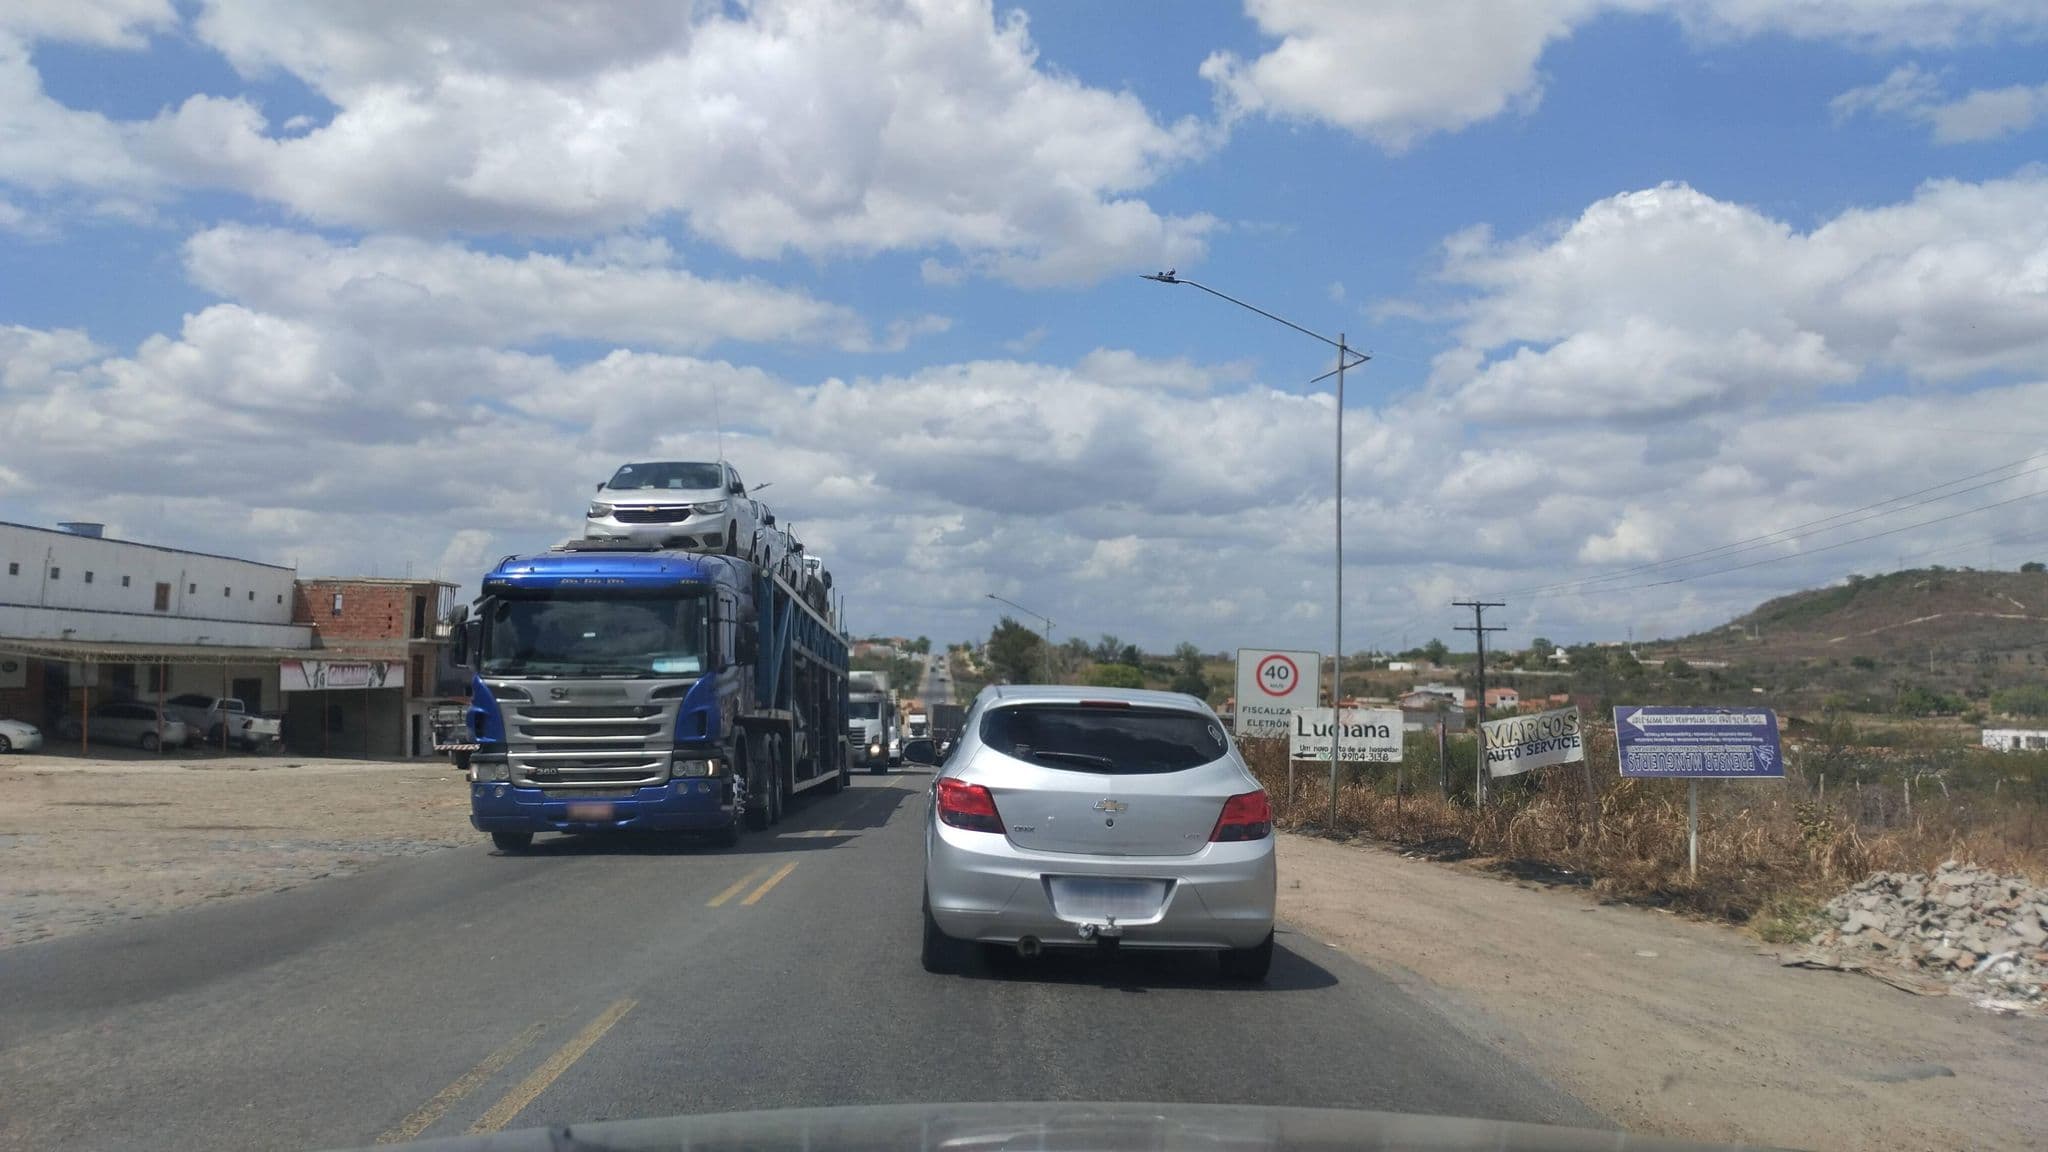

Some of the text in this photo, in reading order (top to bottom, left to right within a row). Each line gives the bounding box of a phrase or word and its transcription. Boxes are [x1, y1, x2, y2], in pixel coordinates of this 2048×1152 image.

[1264, 665, 1289, 680] 40
[1242, 705, 1291, 715] FISCALIZA
[1247, 718, 1289, 728] ELETRÔN
[1483, 711, 1580, 750] MARCOS
[1487, 736, 1580, 762] AUTO SERVICE
[1628, 752, 1703, 771] MANGUEIRAS
